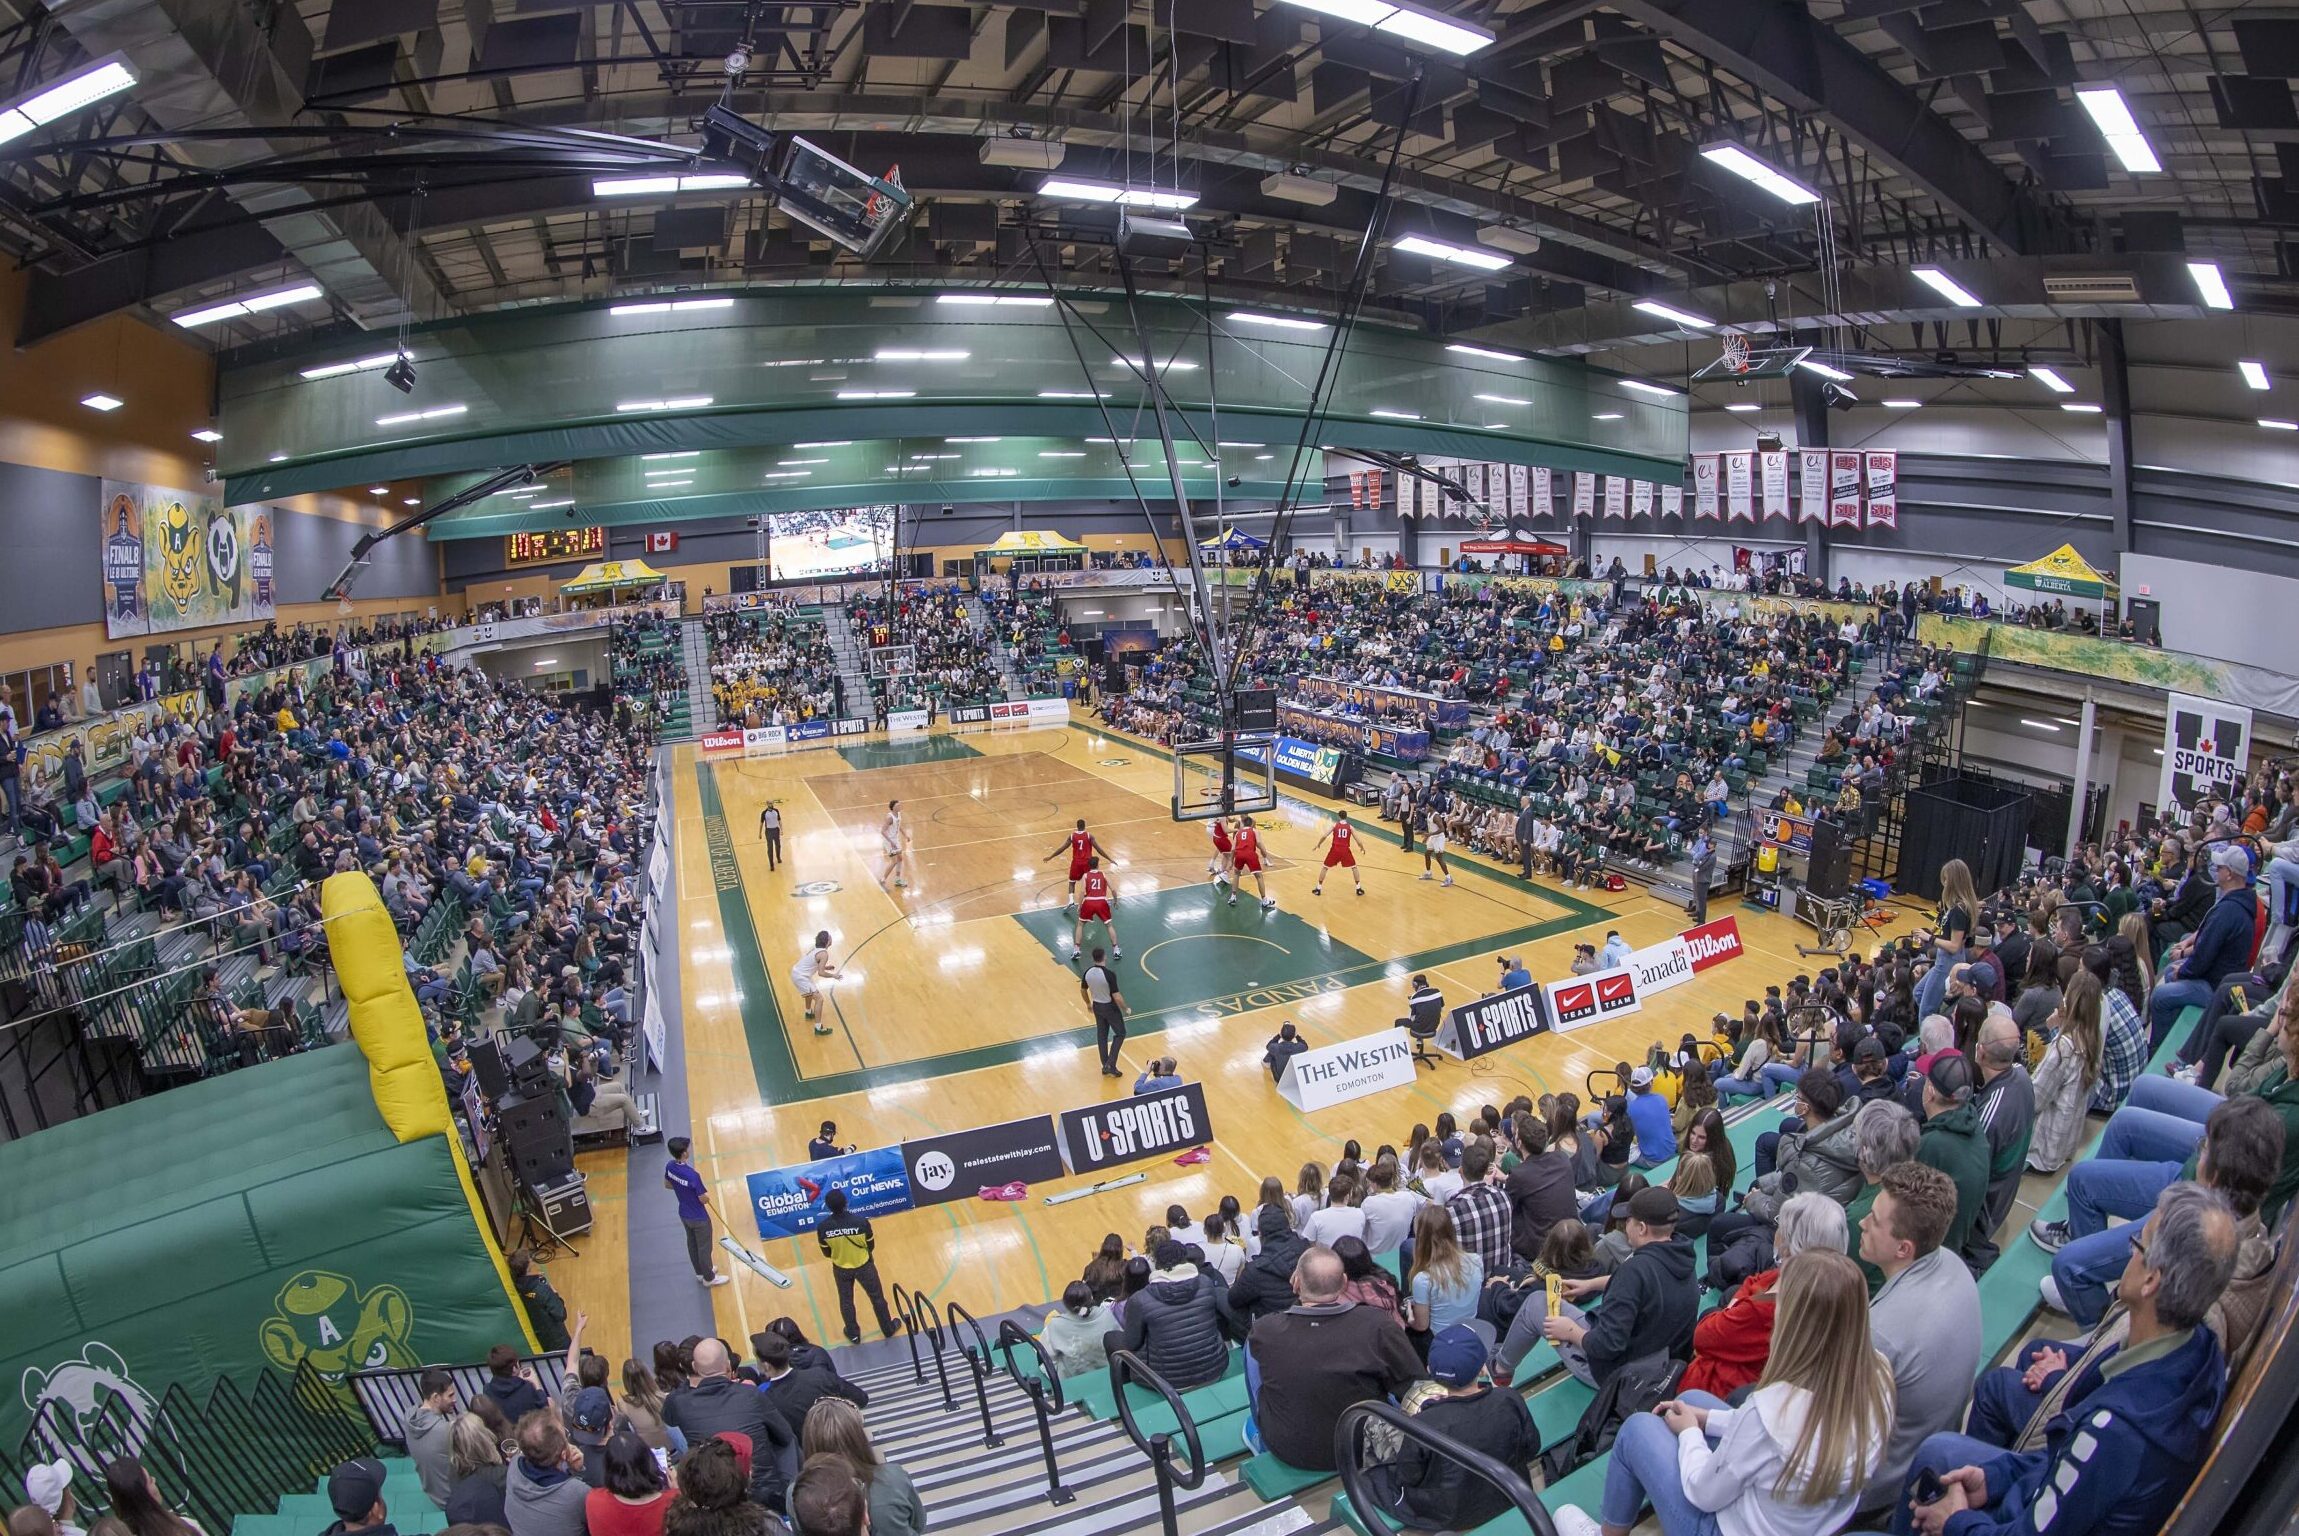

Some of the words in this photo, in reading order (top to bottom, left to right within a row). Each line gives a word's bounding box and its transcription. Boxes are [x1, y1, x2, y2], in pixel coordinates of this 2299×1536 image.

[174, 533, 182, 550] A
[534, 540, 543, 548] 52
[569, 535, 578, 544] 34
[109, 545, 133, 565] FINAL
[133, 546, 139, 565] 8
[253, 553, 268, 566] FINAL
[2042, 581, 2072, 591] ALBERTA
[901, 713, 927, 721] WESTIN
[956, 710, 961, 721] U
[963, 708, 984, 720] SPORTS
[757, 731, 768, 739] BIG
[768, 729, 782, 738] ROCK
[832, 721, 837, 735] U
[840, 719, 865, 734] SPORTS
[702, 736, 741, 748] Wilson
[1287, 745, 1315, 760] ALBERTA
[1276, 754, 1300, 769] GOLDEN
[1326, 757, 1333, 766] A
[2174, 750, 2235, 781] SPORTS
[1241, 831, 1247, 840] 8
[1337, 828, 1348, 838] 10
[1078, 839, 1083, 850] 7
[710, 847, 731, 857] OF
[713, 858, 738, 891] ALBERTA
[1091, 878, 1101, 890] 21
[1687, 934, 1738, 963] Wilson
[1196, 976, 1348, 1018] PANDAS
[1604, 996, 1631, 1009] TEAM
[1563, 1007, 1592, 1020] TEAM
[1465, 1011, 1482, 1050] U
[1482, 993, 1538, 1045] SPORTS
[1298, 1063, 1338, 1084] THE
[1337, 1041, 1409, 1072] WESTIN
[1336, 1072, 1384, 1093] EDMONTON
[1081, 1115, 1104, 1162] U
[1106, 1094, 1195, 1156] SPORTS
[963, 1144, 1052, 1169] realestatewithjay.com
[832, 1180, 849, 1190] Our
[851, 1173, 875, 1186] CITY.
[852, 1185, 870, 1197] Our
[871, 1179, 904, 1192] NEWS.
[758, 1189, 808, 1211] Global
[766, 1203, 808, 1217] EDMONTON
[825, 1226, 859, 1238] SECURITY
[319, 1315, 343, 1346] A
